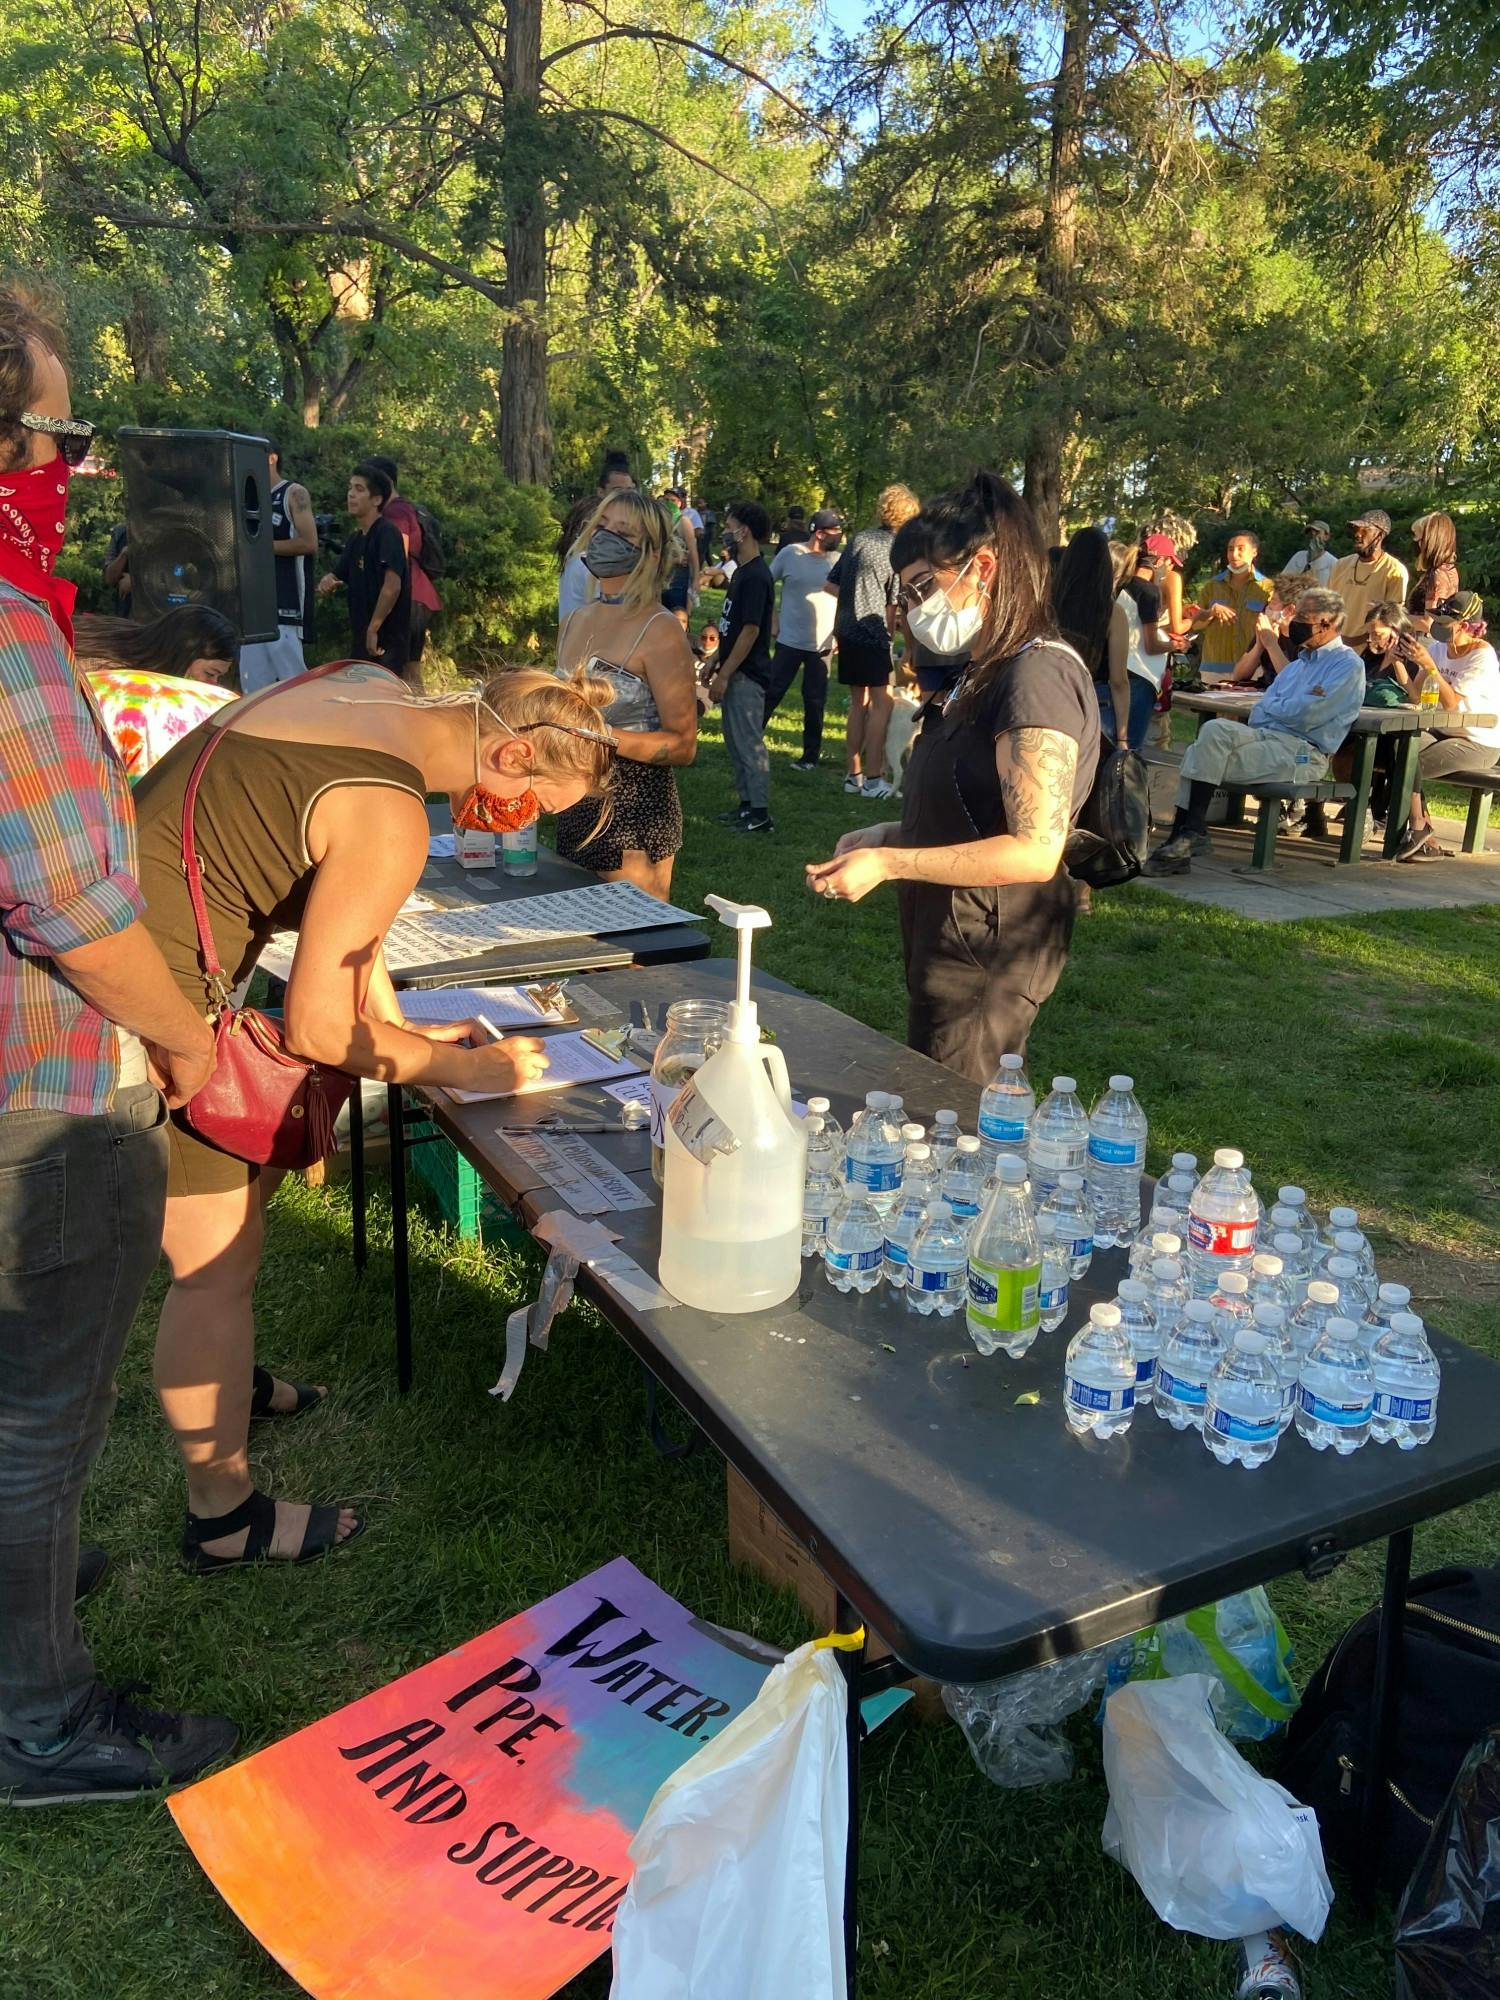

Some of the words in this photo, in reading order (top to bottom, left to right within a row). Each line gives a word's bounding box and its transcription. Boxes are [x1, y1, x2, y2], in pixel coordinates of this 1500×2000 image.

[544, 1597, 730, 1743] WATER,
[337, 1718, 467, 1824] AND
[447, 1821, 629, 1932] SUPPLI
